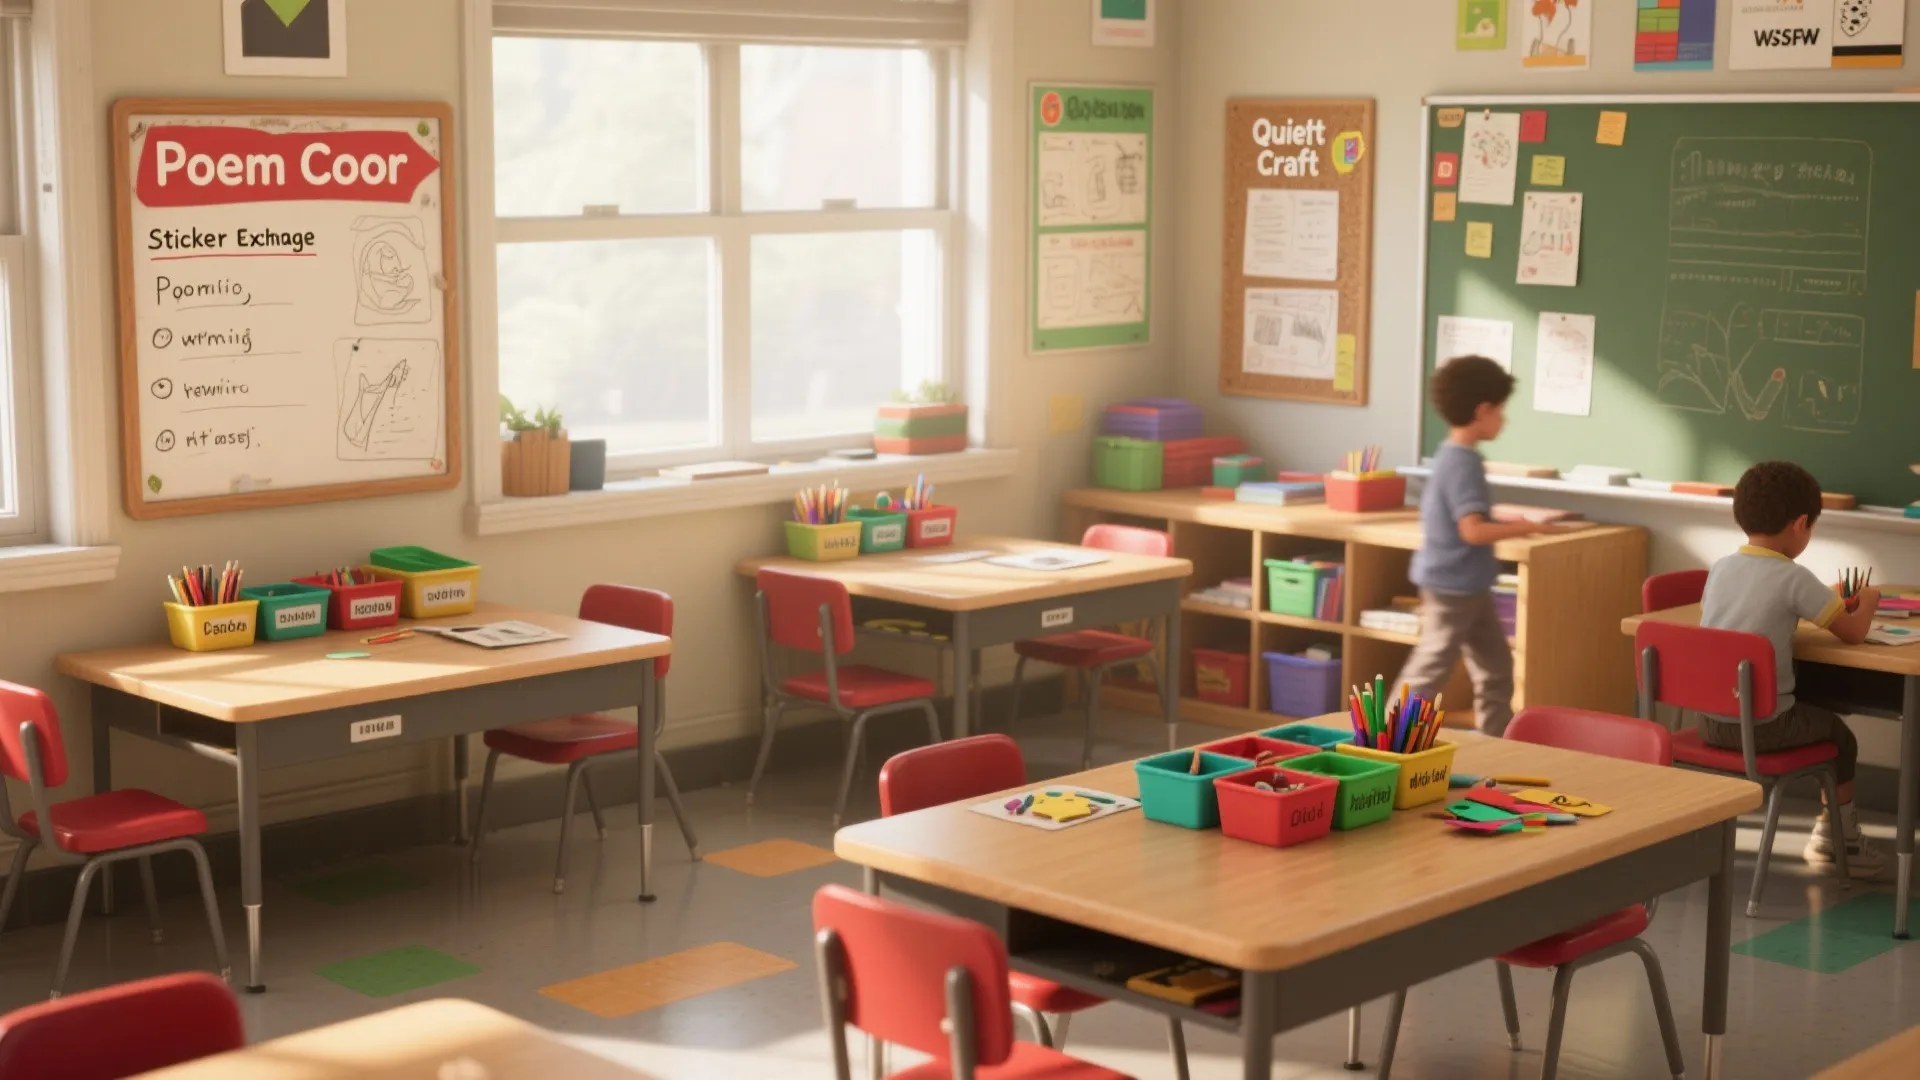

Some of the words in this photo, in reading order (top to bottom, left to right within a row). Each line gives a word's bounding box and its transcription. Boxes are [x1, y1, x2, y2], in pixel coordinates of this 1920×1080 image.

[156, 140, 285, 187] Poem
[300, 142, 408, 187] Coor
[1257, 147, 1320, 177] Craft
[148, 226, 227, 250] Sticker
